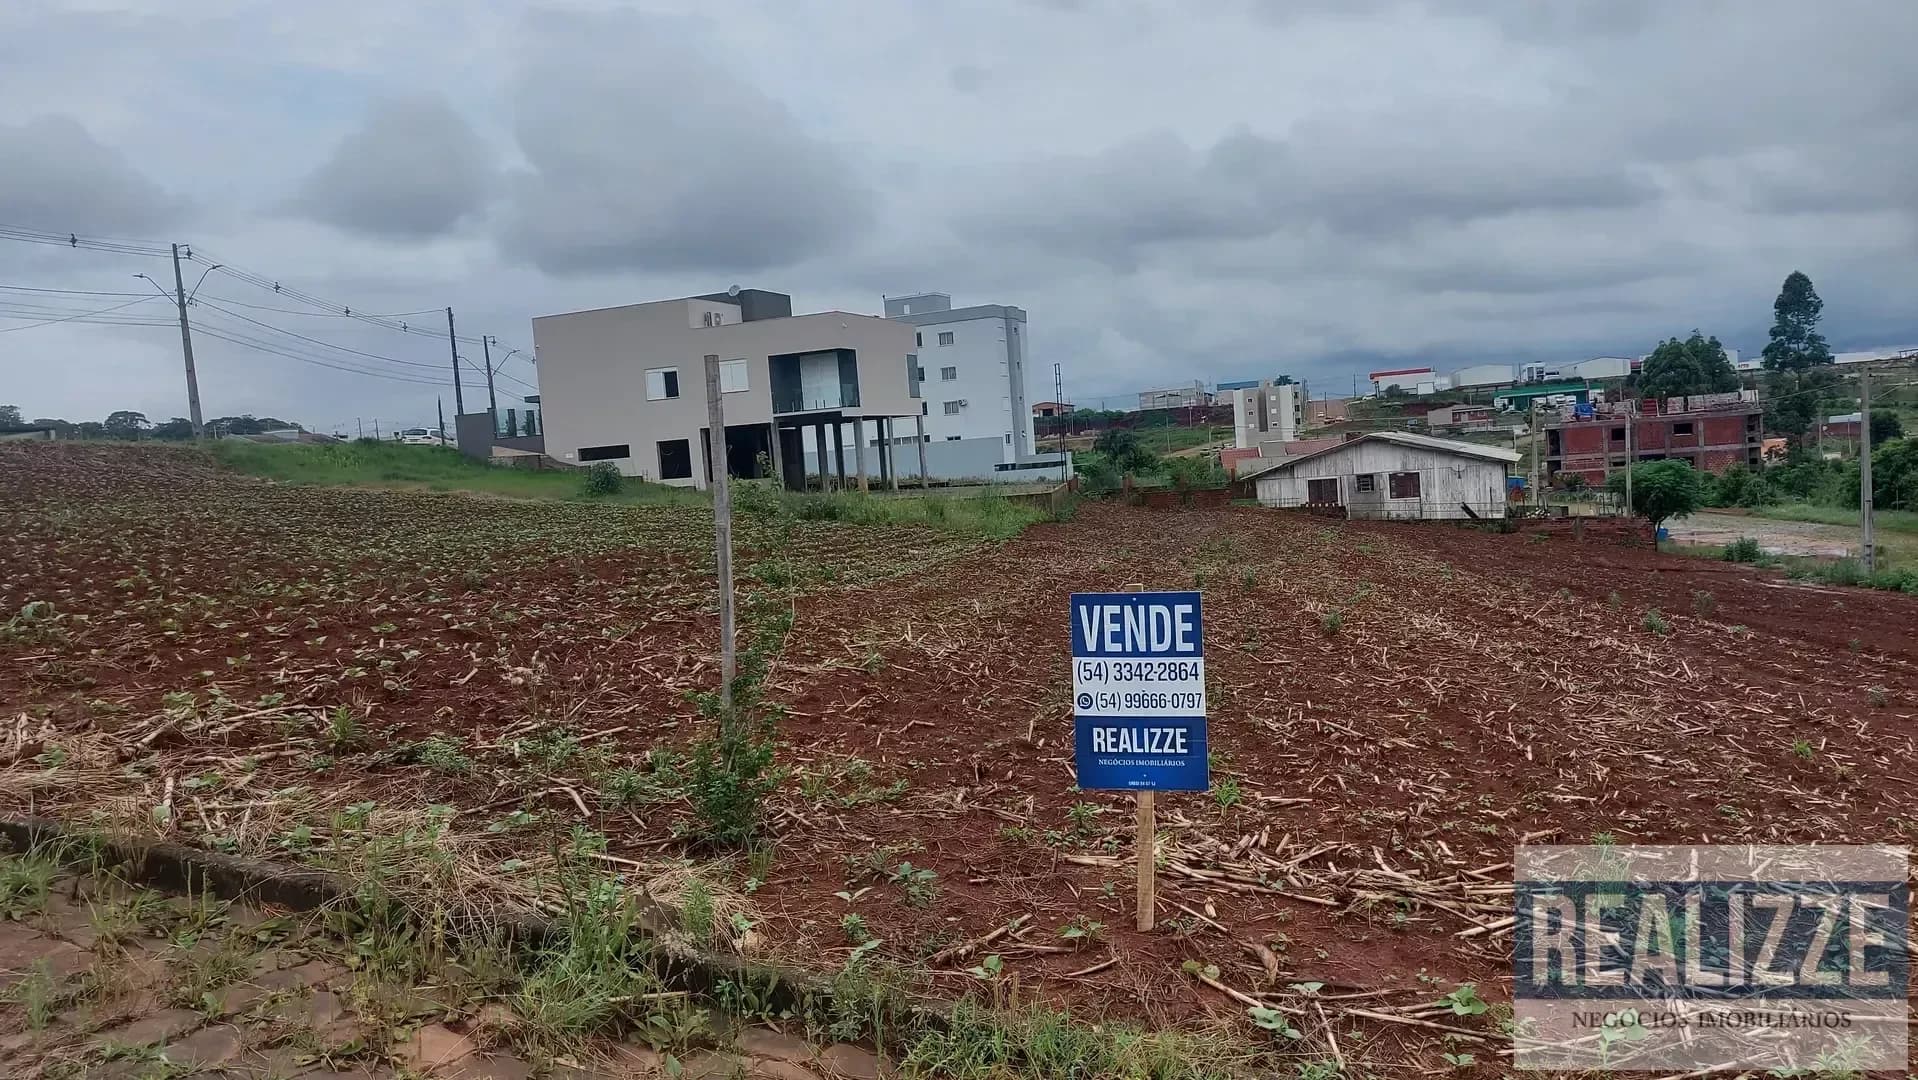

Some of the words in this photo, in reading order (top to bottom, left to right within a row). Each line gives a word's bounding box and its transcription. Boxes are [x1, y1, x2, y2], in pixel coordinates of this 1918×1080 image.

[1079, 604, 1195, 652] VENDE
[1077, 660, 1109, 685] (54)
[1113, 661, 1200, 682] 3342-2864
[1095, 691, 1121, 711] (54)
[1124, 692, 1202, 709] 99666-0797
[1092, 727, 1189, 754] REALIZZE
[1098, 758, 1135, 767] NEGÓCIOS
[1135, 759, 1186, 767] IMOBILIÁRIOS
